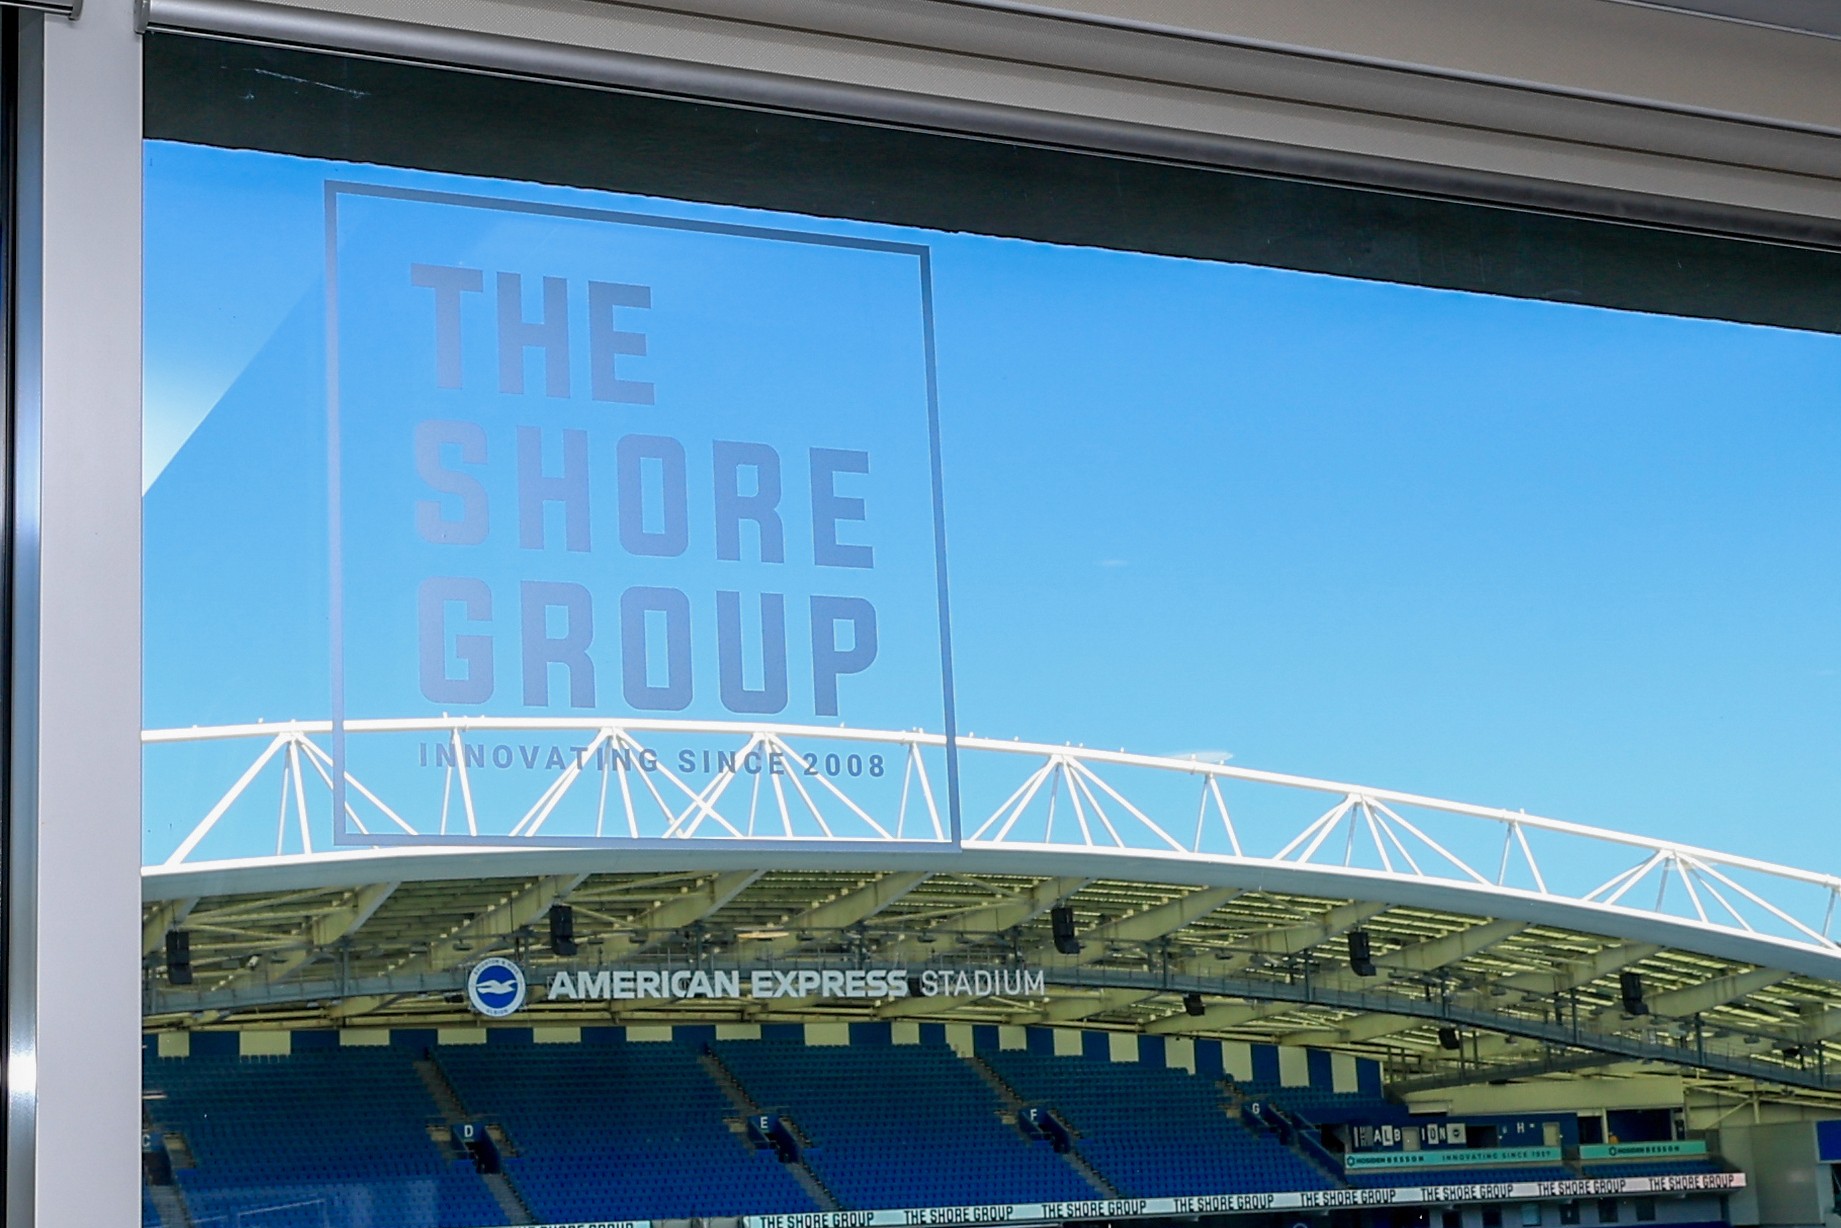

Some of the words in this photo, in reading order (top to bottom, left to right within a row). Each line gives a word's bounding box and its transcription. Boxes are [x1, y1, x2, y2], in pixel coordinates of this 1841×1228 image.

[411, 262, 655, 405] THE
[413, 419, 874, 569] SHORE
[418, 576, 878, 716] GROUP
[419, 741, 658, 773] INNOVATING
[678, 749, 785, 776] SINCE
[802, 753, 886, 779] 2008
[548, 969, 739, 999] AMERICAN
[752, 968, 909, 998] EXPRESS
[921, 968, 1046, 997] STADIUM
[760, 1116, 769, 1129] E
[1030, 1109, 1038, 1121] F
[464, 1124, 474, 1138] D
[1537, 1183, 1555, 1197] THE
[1558, 1181, 1590, 1195] SHORE
[1593, 1179, 1626, 1193] GROUP
[1649, 1178, 1666, 1191] THE
[1669, 1176, 1699, 1190] SHORE
[1703, 1174, 1734, 1188] GROUP
[1301, 1193, 1319, 1207] THE
[1322, 1191, 1358, 1206] SHORE
[1361, 1189, 1396, 1204] GROUP
[1421, 1188, 1440, 1202] THE
[1443, 1186, 1476, 1201] SHORE
[1480, 1184, 1514, 1198] GROUP
[1042, 1204, 1063, 1218] THE
[1067, 1202, 1104, 1218] SHORE
[1108, 1200, 1147, 1216] GROUP
[1174, 1198, 1194, 1213] THE
[1198, 1196, 1234, 1212] SHORE
[1237, 1194, 1274, 1210] GROUP
[833, 1212, 874, 1228] GROUP
[904, 1210, 926, 1225] THE
[930, 1208, 970, 1224] SHORE
[974, 1206, 1014, 1222] GROUP
